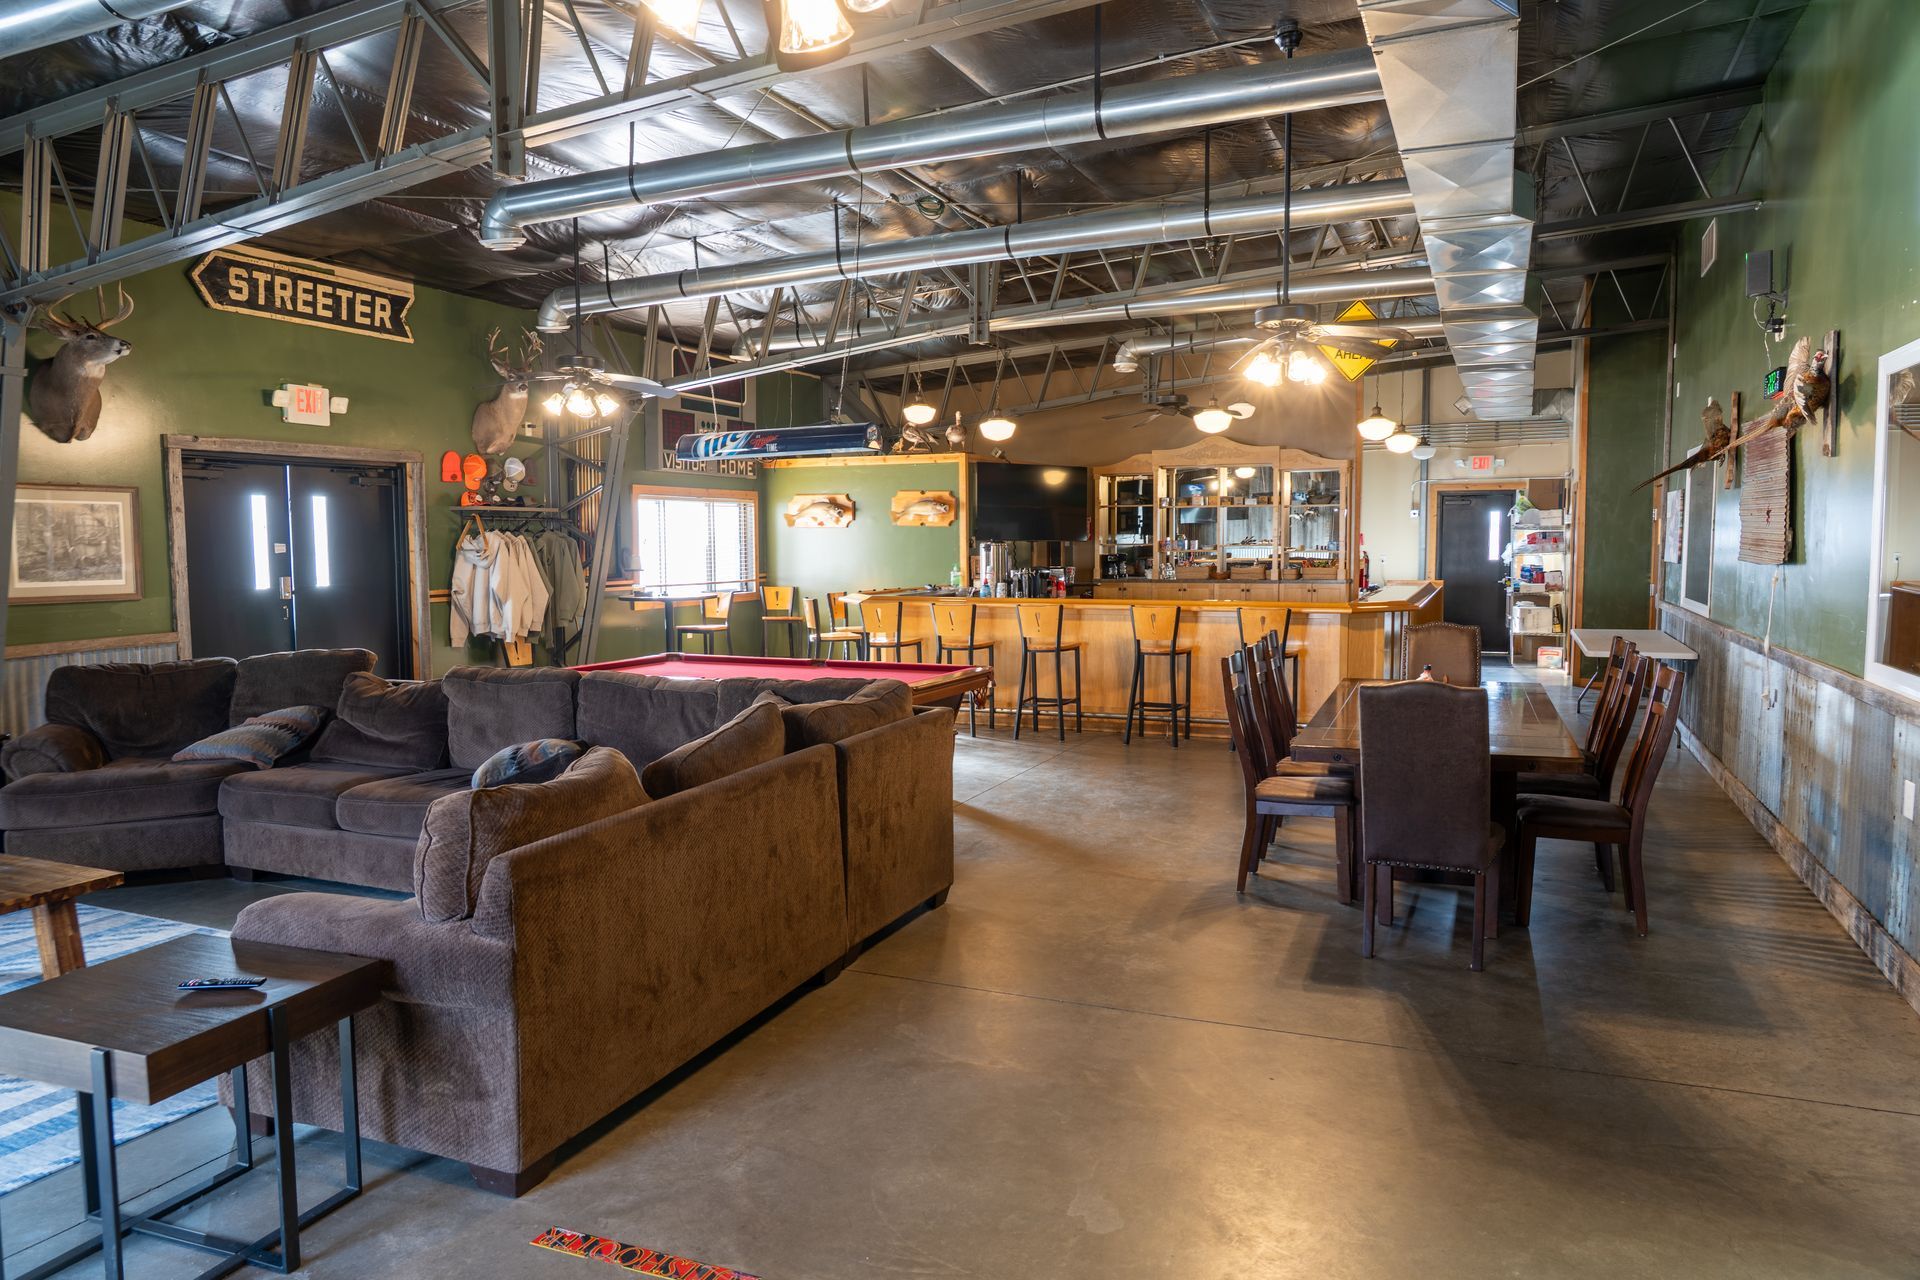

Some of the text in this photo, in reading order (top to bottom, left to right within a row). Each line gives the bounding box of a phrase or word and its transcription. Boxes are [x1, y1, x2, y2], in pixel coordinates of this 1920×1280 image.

[228, 266, 392, 329] STREETER
[296, 388, 323, 415] EXIT
[720, 459, 754, 477] HOME
